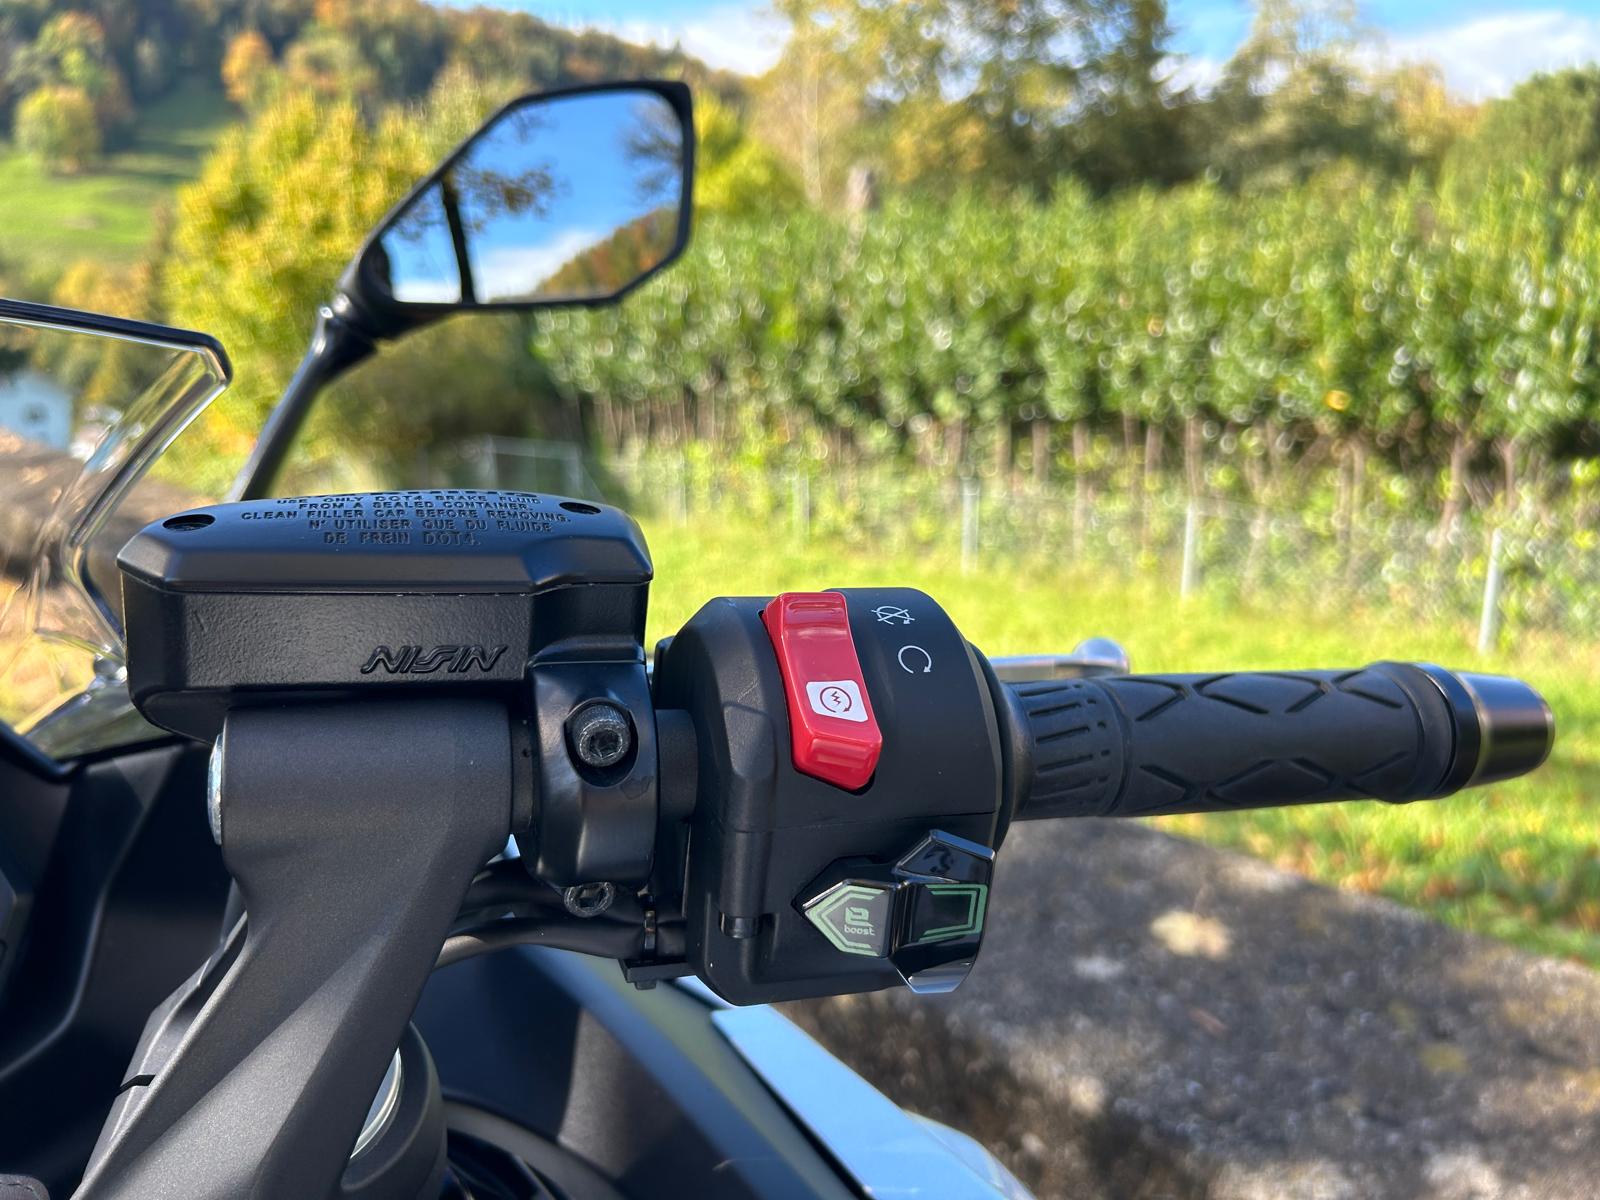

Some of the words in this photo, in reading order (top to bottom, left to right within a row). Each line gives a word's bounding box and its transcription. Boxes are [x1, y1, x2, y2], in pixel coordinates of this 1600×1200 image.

[372, 501, 434, 509] SEALED
[443, 501, 534, 511] CONTAINER.
[241, 510, 298, 520] CLEAN
[307, 509, 364, 518] FILLER
[374, 509, 407, 518] CAP
[415, 509, 479, 518] BEFORE
[487, 510, 572, 523] REMOVING.
[335, 519, 413, 530] UTILISER
[421, 519, 457, 530] QUE
[465, 519, 488, 531] DU
[498, 520, 553, 532] FLUIDE
[323, 531, 348, 545] DE
[359, 531, 411, 545] FREIN
[422, 531, 482, 546] DOT4.
[844, 924, 876, 936] boost
